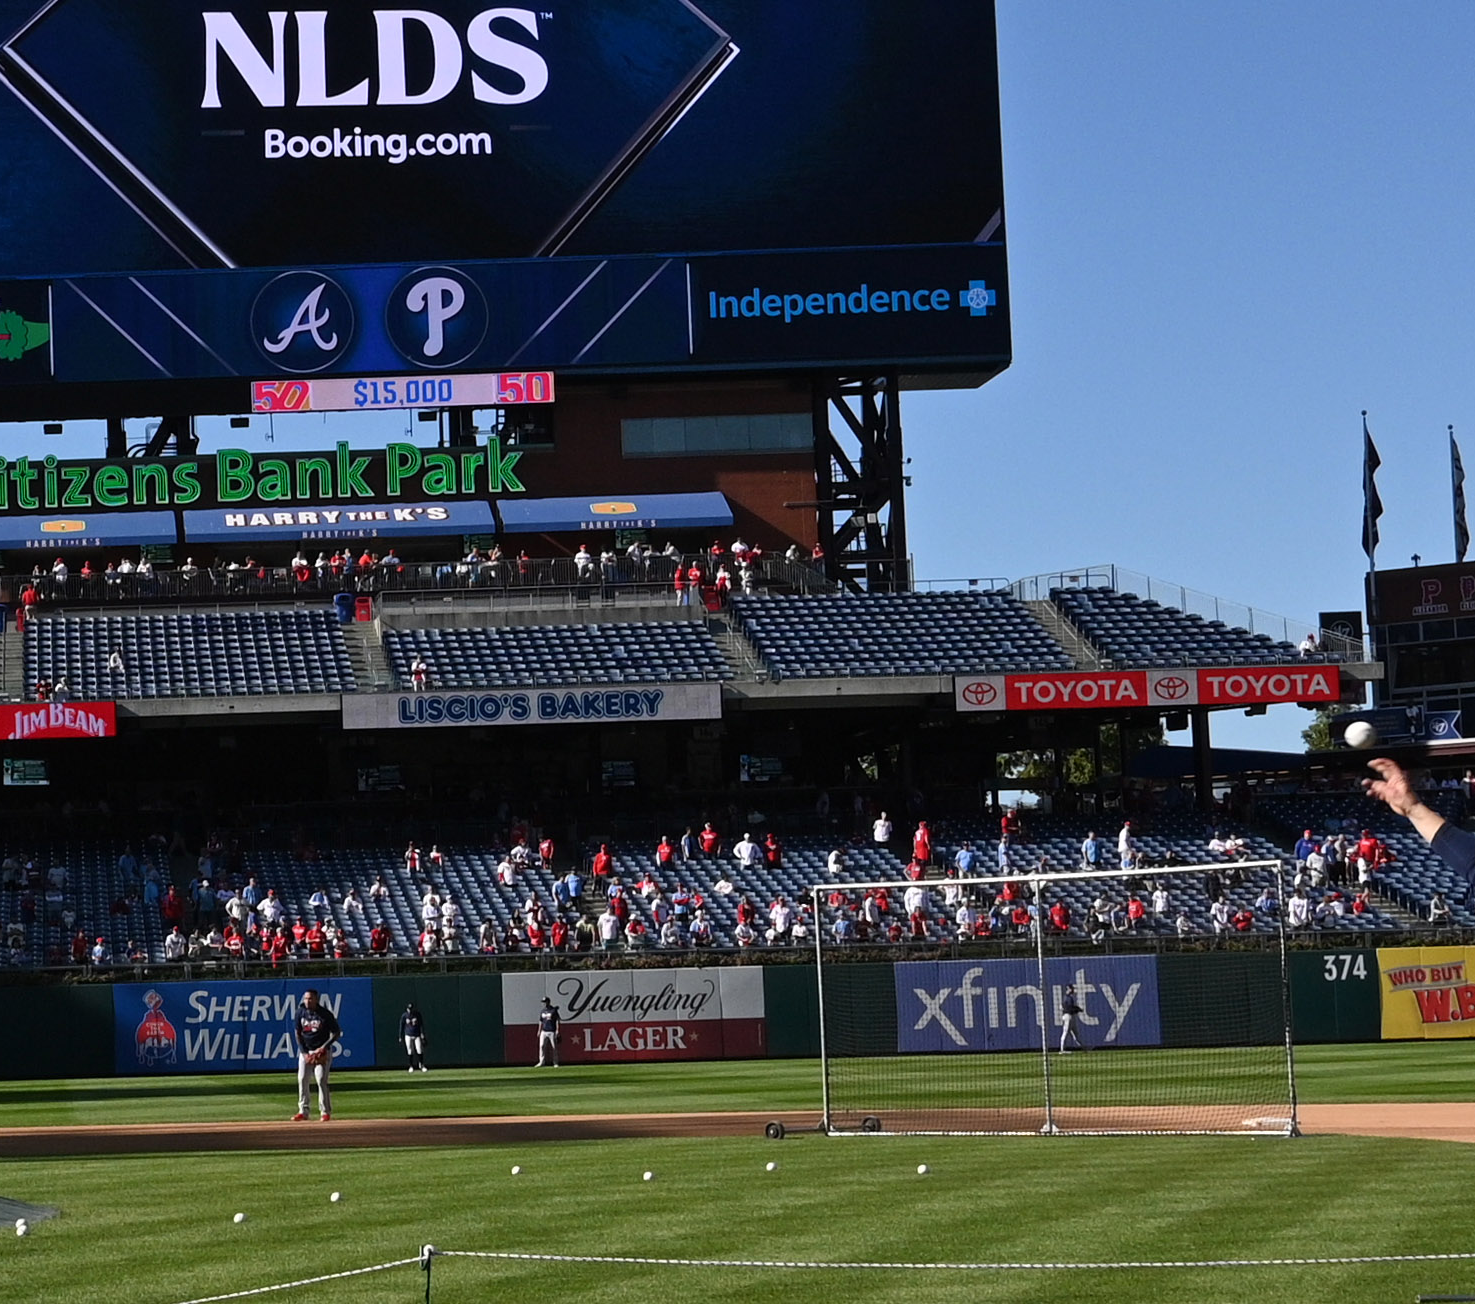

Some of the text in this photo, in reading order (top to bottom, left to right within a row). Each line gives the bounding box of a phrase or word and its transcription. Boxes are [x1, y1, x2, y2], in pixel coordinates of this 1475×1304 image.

[201, 7, 549, 108] NLDS
[264, 126, 492, 164] Booking.com
[709, 283, 951, 323] Independence
[353, 379, 453, 408] $15,000
[216, 440, 375, 503] Bank
[386, 436, 526, 496] Park
[225, 507, 450, 527] HARRY THE K'S
[1014, 679, 1138, 703] TOYOTA
[1207, 673, 1331, 698] TOYOTA
[8, 703, 106, 741] JIM BEAM
[400, 690, 663, 724] LISCIO'S BAKERY
[1322, 954, 1368, 981] 374
[1387, 964, 1464, 987] WHO BUT
[184, 990, 342, 1025] SHERWN
[557, 977, 715, 1022] Yuengling
[912, 966, 1141, 1047] xfinity
[583, 1026, 687, 1051] LAGER
